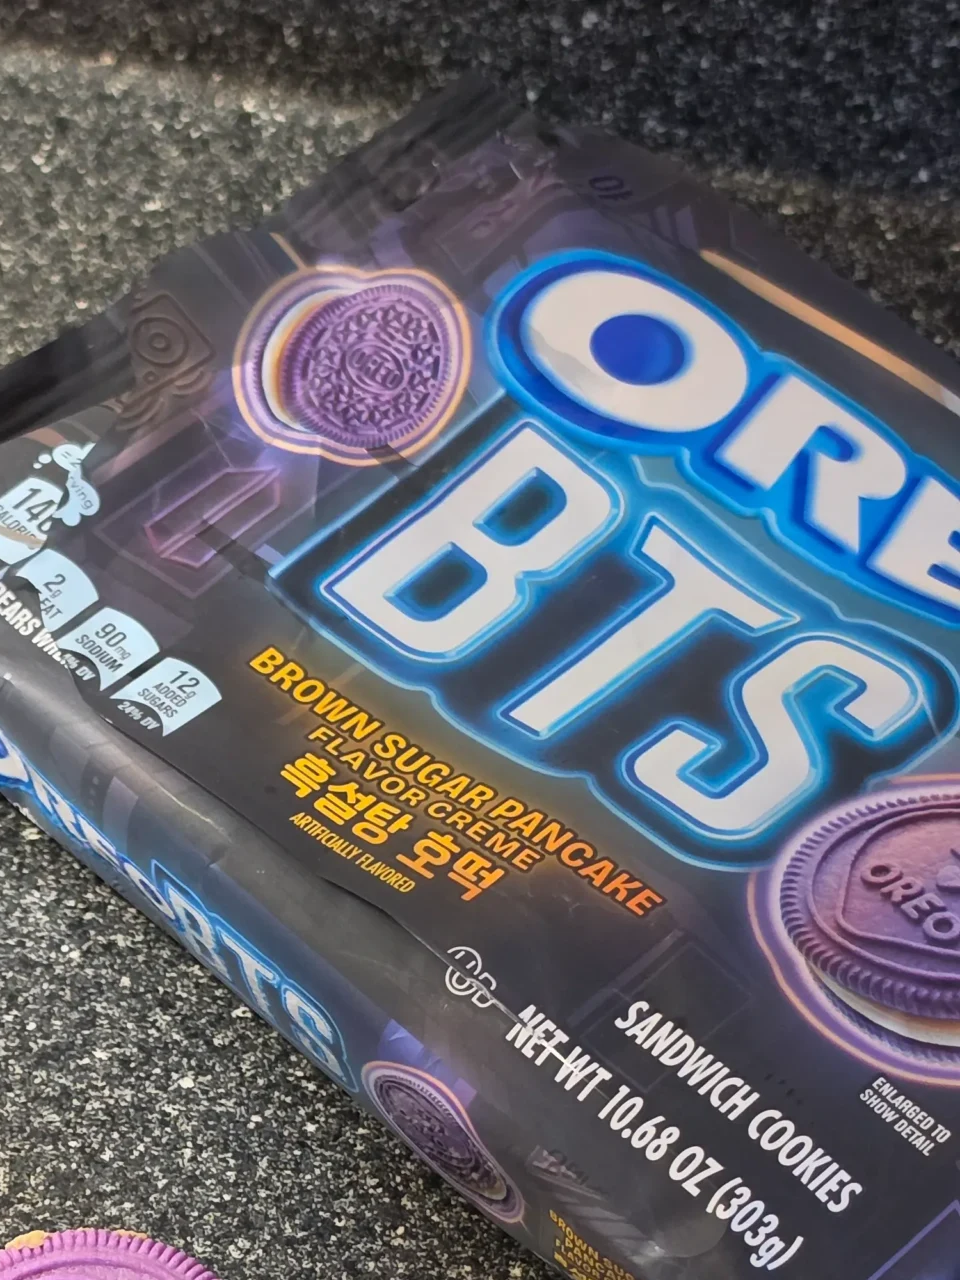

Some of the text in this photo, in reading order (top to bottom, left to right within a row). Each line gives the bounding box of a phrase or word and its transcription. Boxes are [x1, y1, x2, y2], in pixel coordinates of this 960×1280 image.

[75, 634, 123, 673] SODIUM
[323, 421, 924, 836] BTS
[75, 665, 96, 681] DV
[137, 688, 178, 718] SUGARS
[152, 682, 187, 708] ADDED
[117, 701, 160, 730] 24% DV
[249, 646, 662, 916] BROWN SUGAR PANCAKE
[308, 727, 542, 871] FLAVOR CREME
[280, 752, 504, 901] 흑설탕 호떡
[289, 812, 415, 893] ARTIFICIALLY FLAVORED
[861, 862, 960, 940] OREO
[505, 1004, 569, 1066] NET
[554, 1045, 613, 1102] WT
[597, 1084, 681, 1161] 10.68
[668, 1146, 724, 1197] OZ
[705, 1176, 804, 1271] (303g)
[614, 1001, 864, 1213] SANDWICH COOKIES
[859, 1089, 934, 1156] SHOW DETAIL
[872, 1077, 951, 1143] ENLARGED TO
[549, 1209, 599, 1260] BROWN
[555, 1238, 600, 1279] FLAVOR
